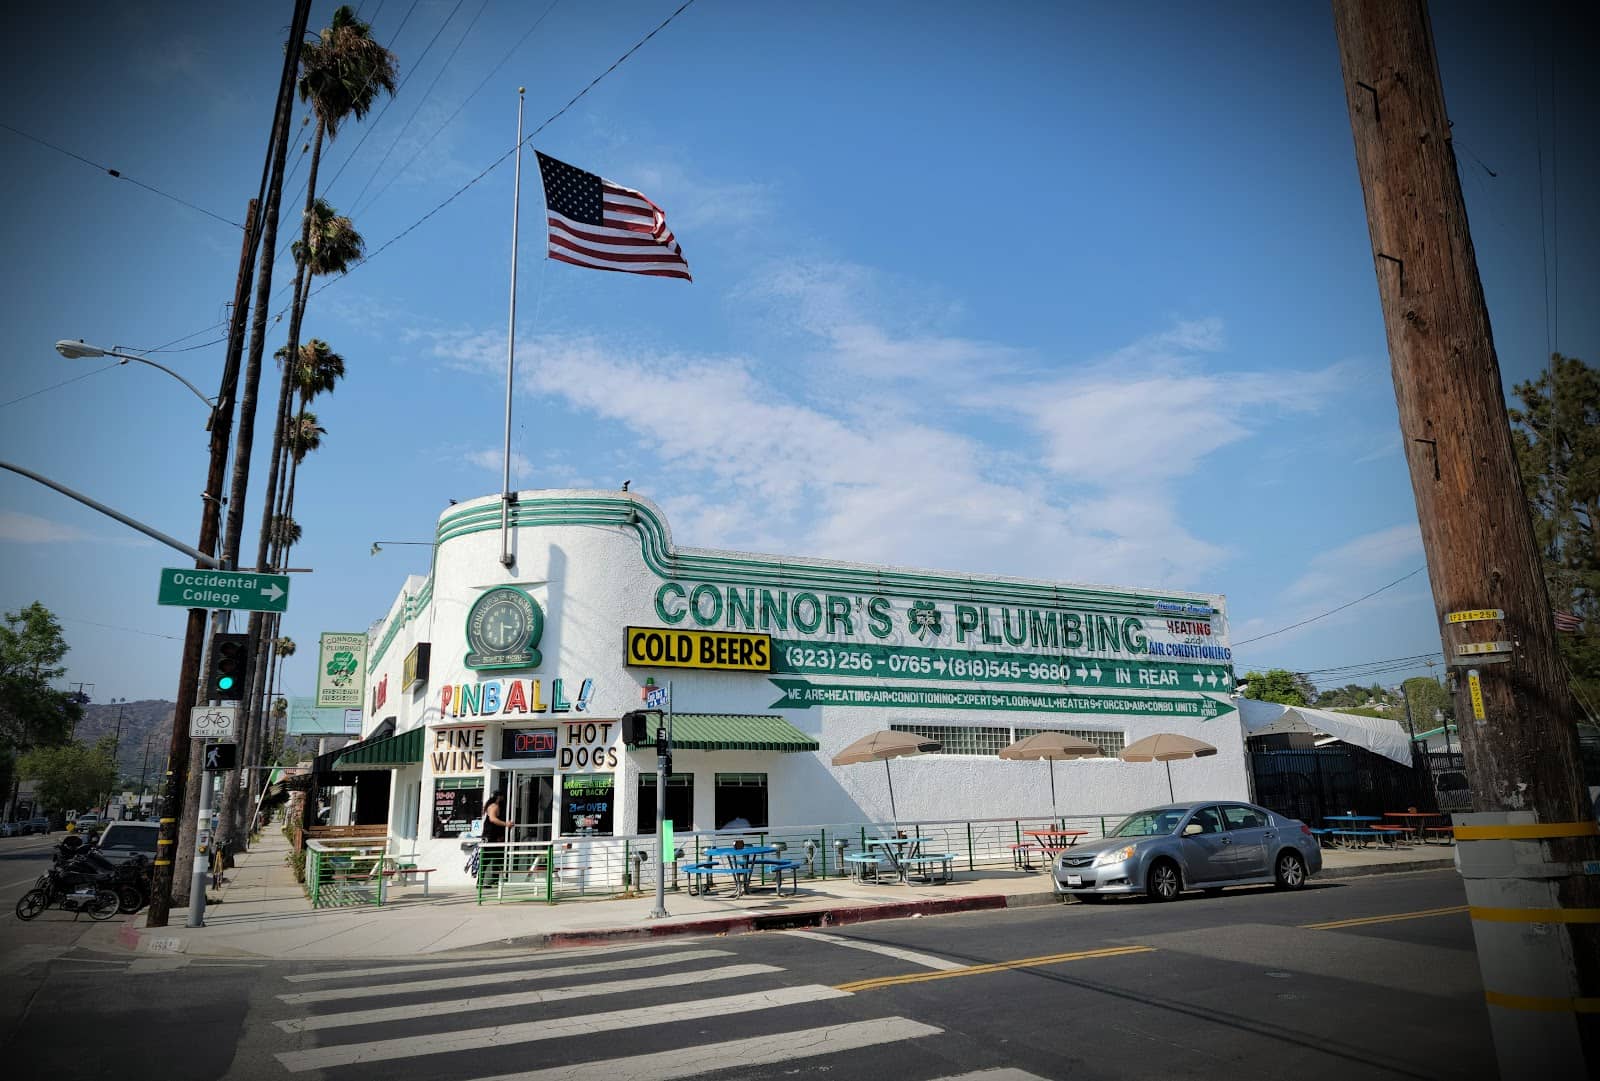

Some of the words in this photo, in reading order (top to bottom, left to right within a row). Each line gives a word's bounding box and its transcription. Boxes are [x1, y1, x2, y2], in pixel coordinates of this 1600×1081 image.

[173, 573, 257, 589] Occidental
[182, 588, 240, 606] College
[654, 582, 893, 639] CONNOR'S
[954, 603, 1149, 655] PLUMBING
[1167, 620, 1211, 636] HEATING
[632, 633, 693, 663] COLD
[700, 636, 768, 667] BEERS
[1149, 641, 1166, 656] AIR
[1166, 642, 1231, 660] CONDITIONING
[1115, 667, 1132, 684] IN
[1138, 669, 1180, 686] REAR
[440, 678, 594, 719] PINBALL!
[787, 688, 802, 700] WE
[1175, 702, 1198, 713] UNITS
[435, 729, 485, 749] FINE
[515, 734, 554, 751] OPEN
[566, 723, 613, 745] HOT
[431, 750, 485, 772] WINE
[560, 746, 618, 769] DOGS
[569, 789, 584, 797] OUT
[586, 802, 608, 812] OVER
[473, 821, 481, 830] A
